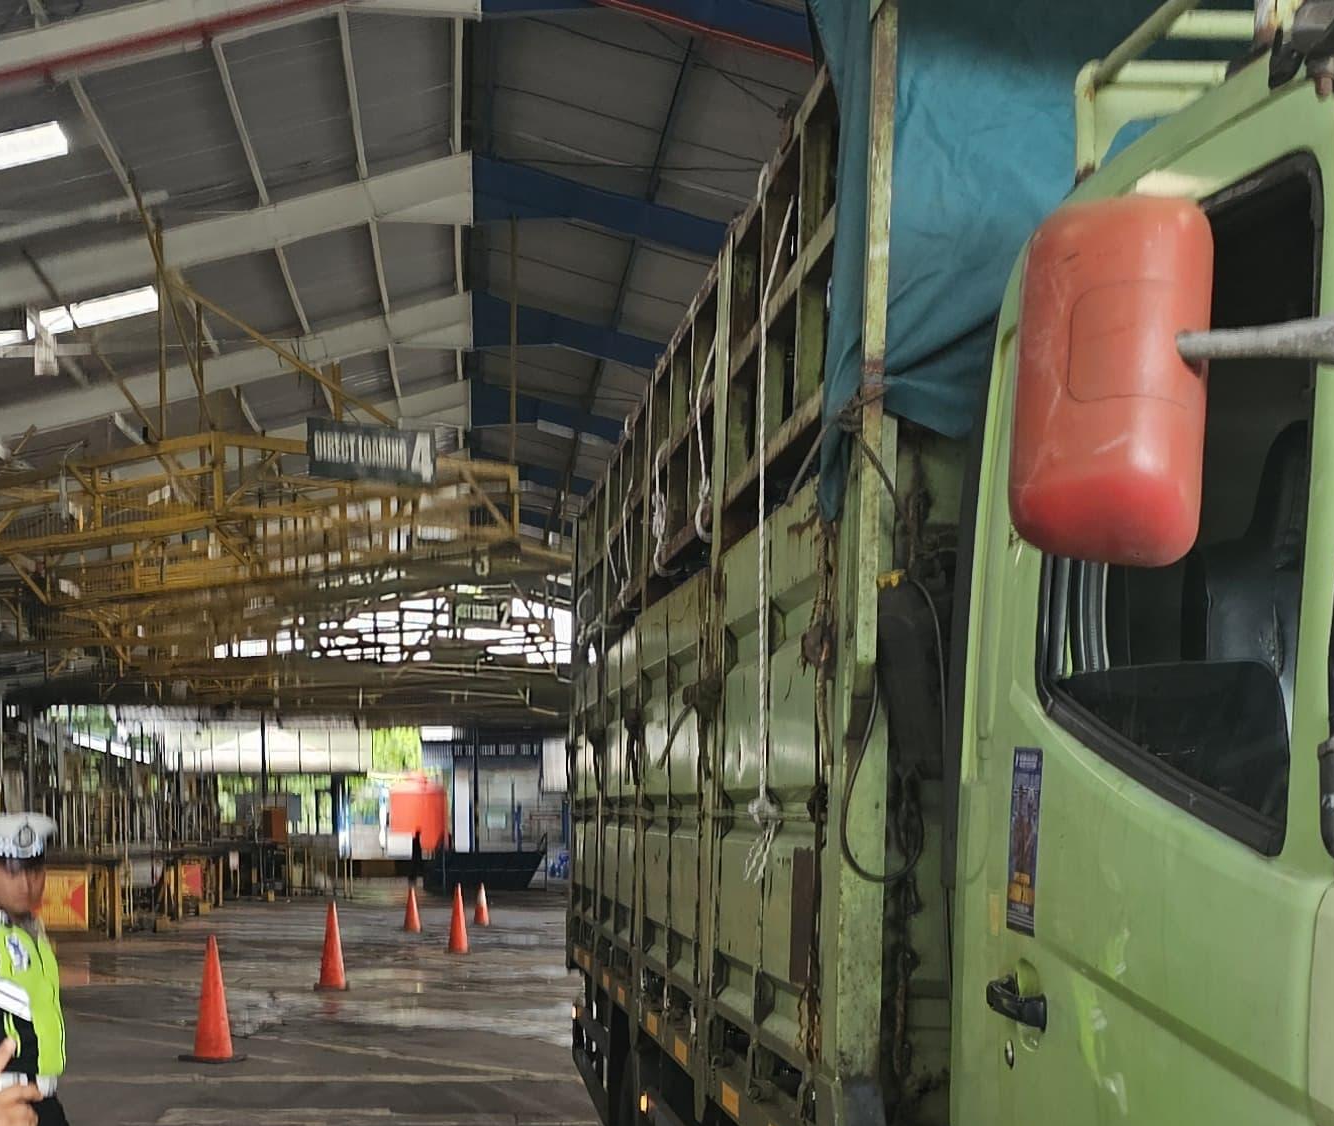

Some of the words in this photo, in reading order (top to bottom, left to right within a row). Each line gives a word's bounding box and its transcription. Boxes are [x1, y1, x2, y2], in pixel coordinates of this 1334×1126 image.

[314, 430, 355, 464] DIRECT
[358, 435, 407, 471] LOADING
[411, 432, 434, 483] 4
